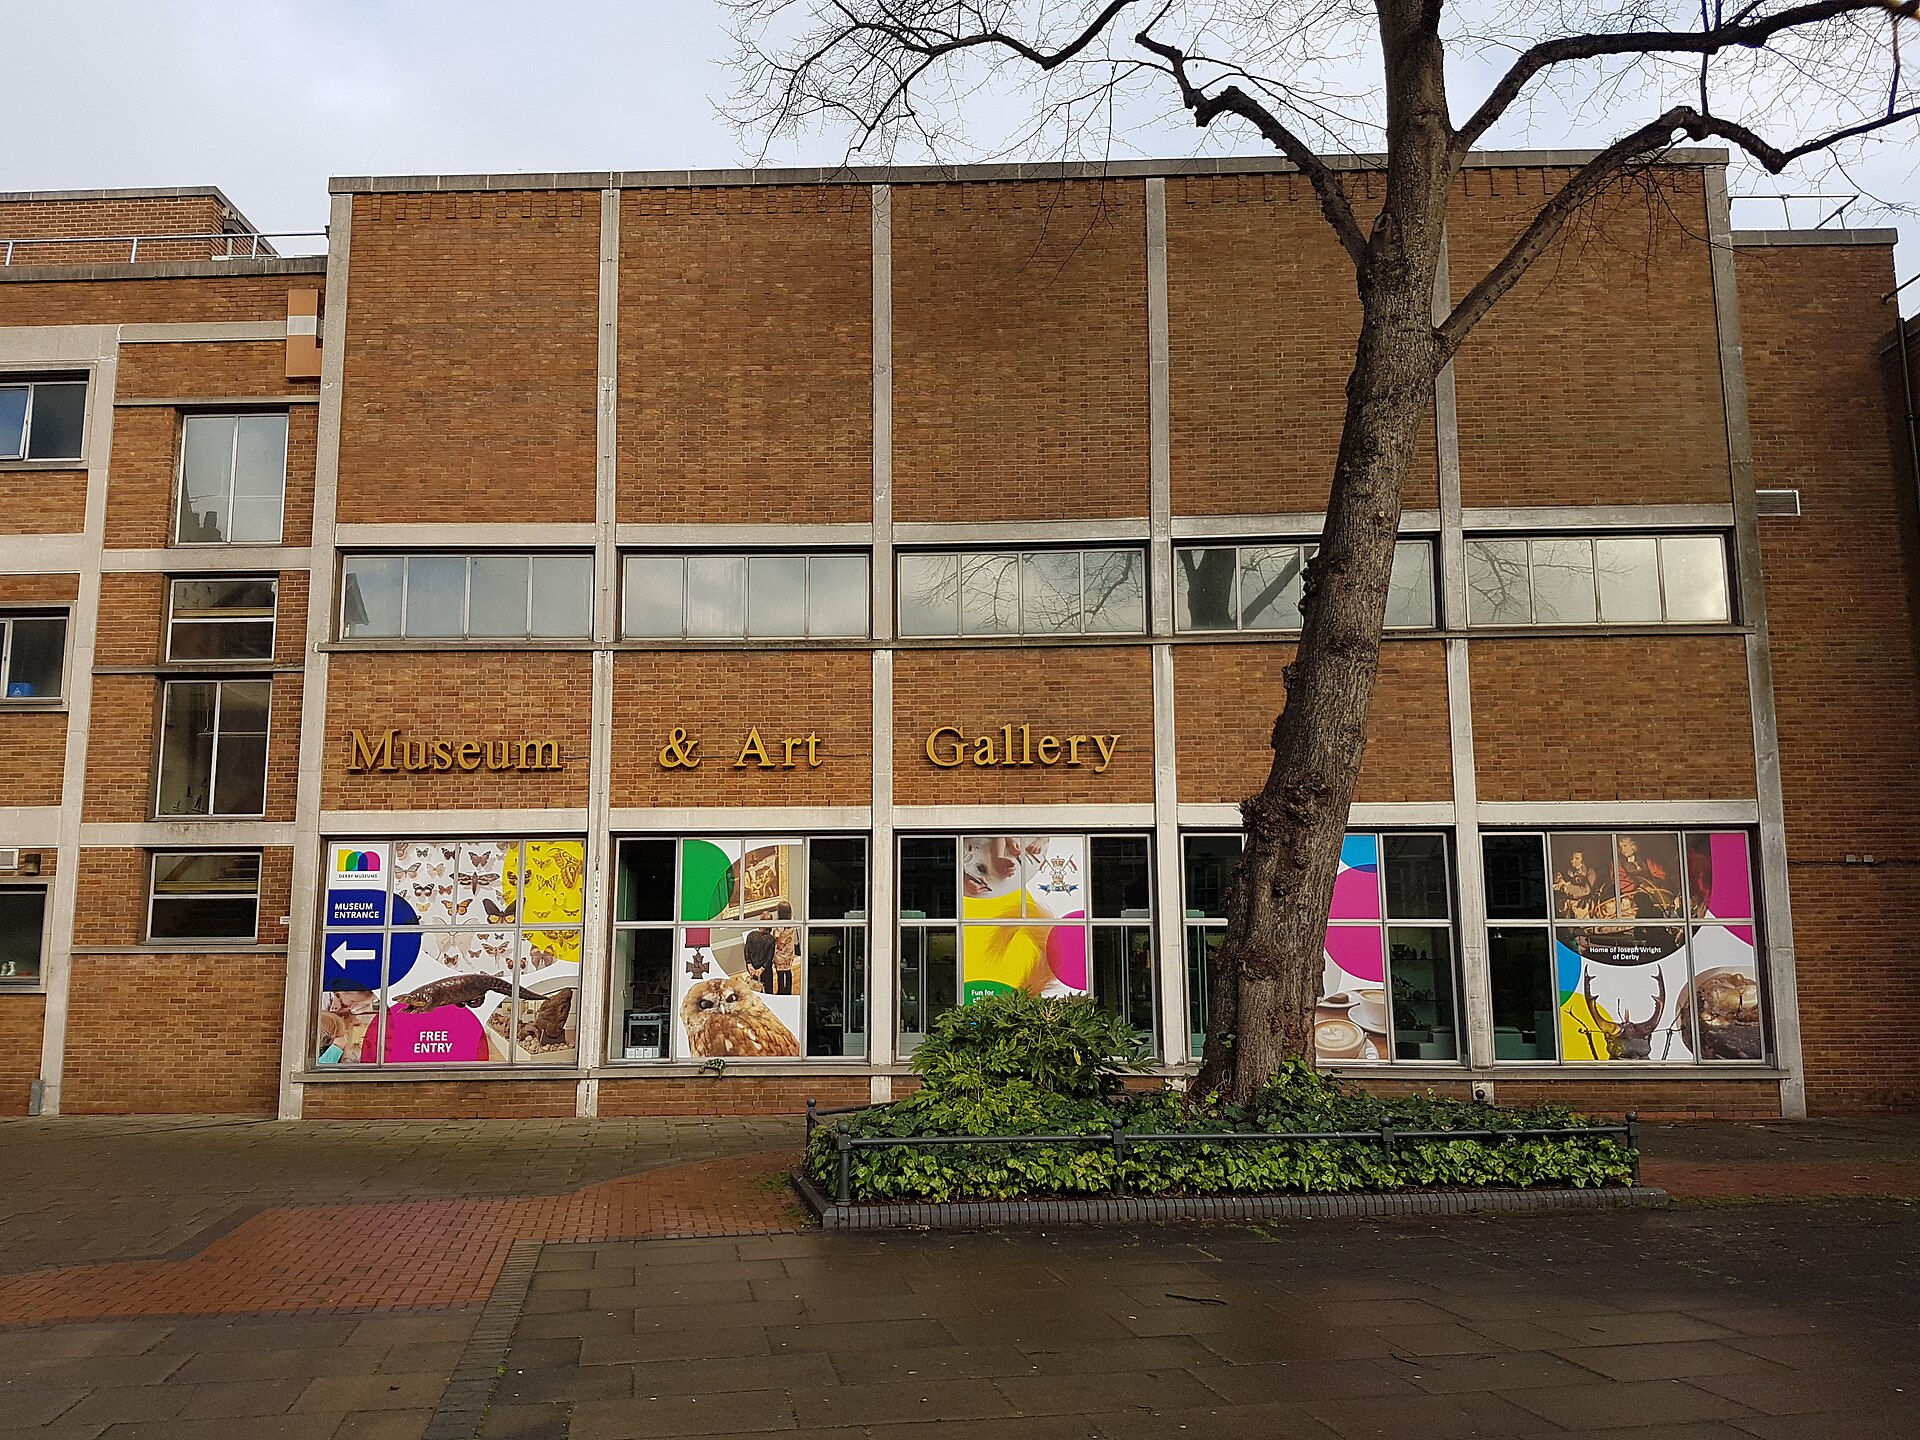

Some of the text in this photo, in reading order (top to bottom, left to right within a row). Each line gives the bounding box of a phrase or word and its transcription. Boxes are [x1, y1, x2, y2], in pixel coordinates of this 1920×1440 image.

[347, 723, 1121, 773] Museum & Art Gallery
[334, 902, 374, 911] MUSEUM
[334, 911, 380, 919] ENTRANCE
[1617, 946, 1639, 954] Joseph
[1639, 946, 1662, 954] Wright
[419, 1031, 449, 1041] FREE
[413, 1042, 453, 1053] ENTRY
